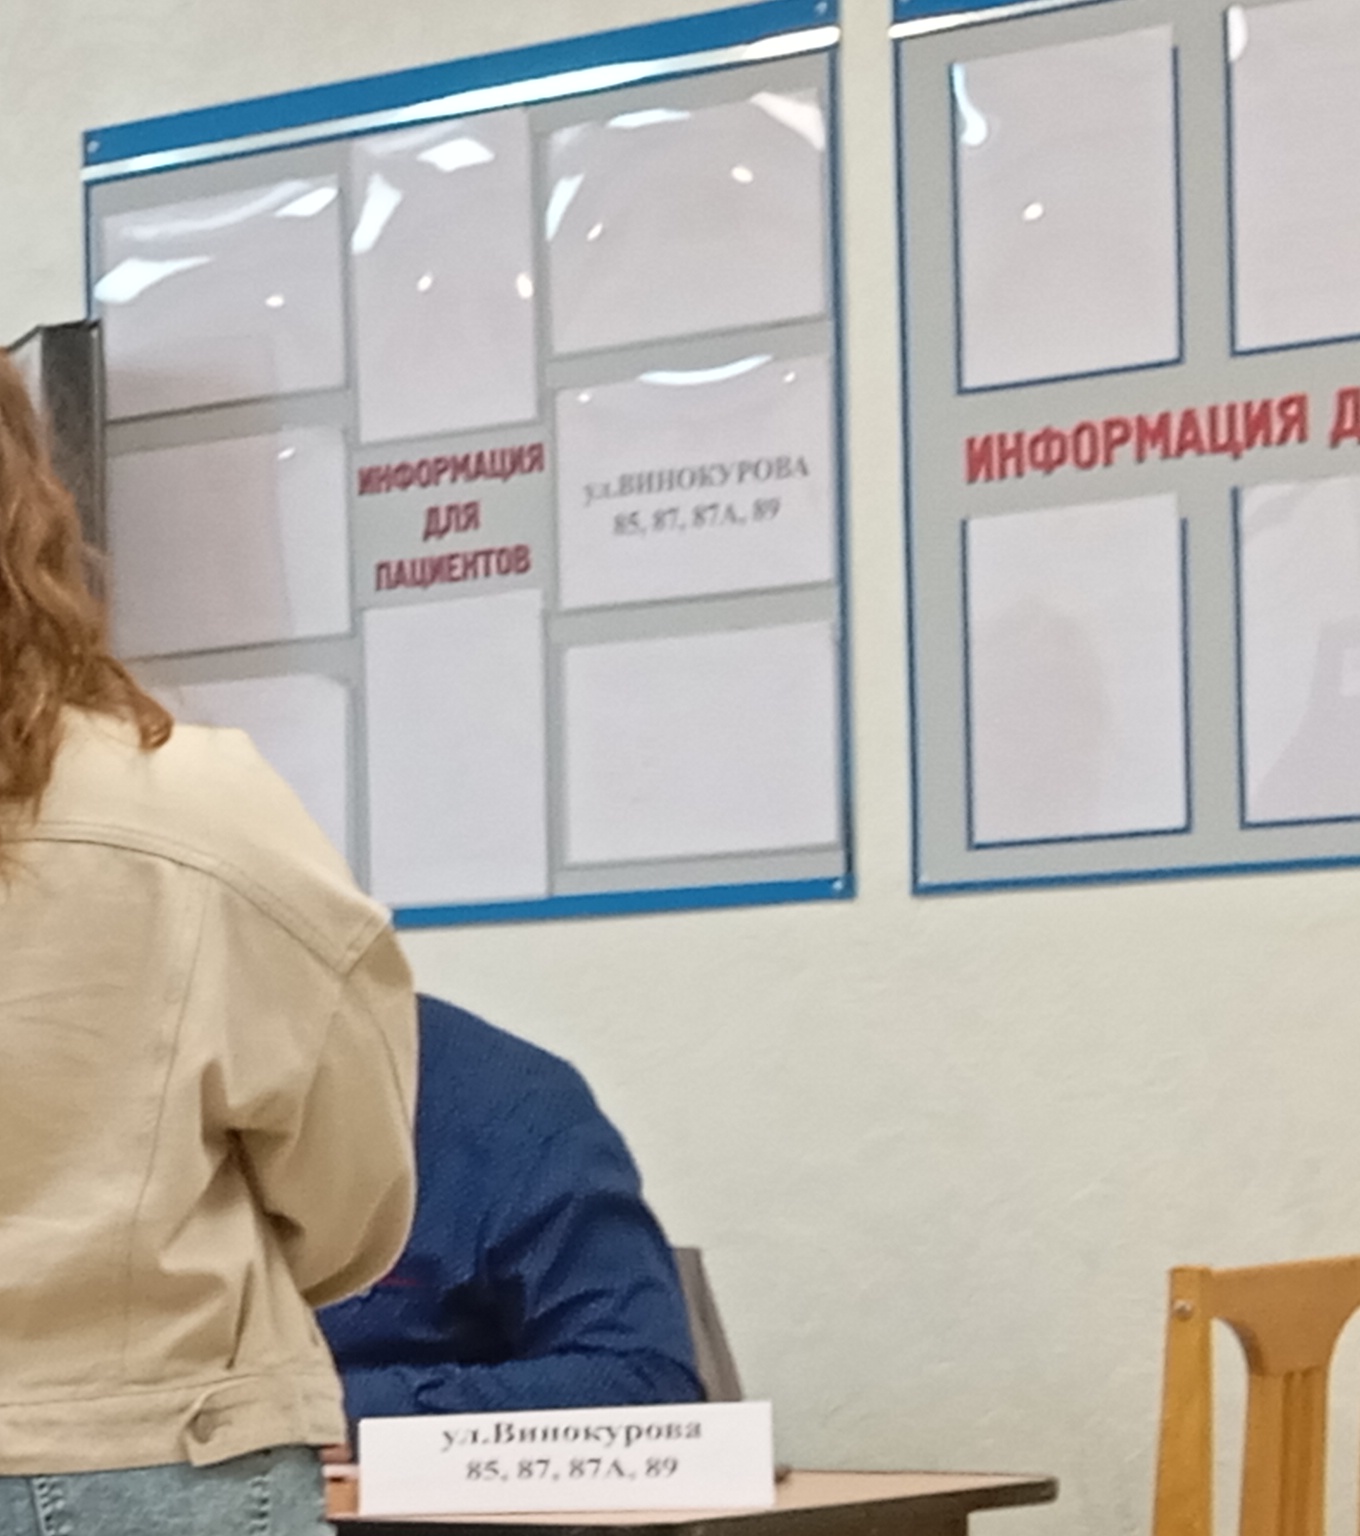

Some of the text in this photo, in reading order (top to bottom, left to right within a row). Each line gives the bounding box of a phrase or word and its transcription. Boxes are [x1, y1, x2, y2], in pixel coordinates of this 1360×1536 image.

[965, 393, 1309, 484] ИНФОРМАЦИЯ
[358, 443, 545, 496] ИНФОРМАЦИЯ
[583, 454, 810, 507] ул.ВИНОКУРОВА
[423, 501, 481, 541] ДЛЯ
[613, 511, 647, 537] 85,
[652, 506, 687, 532] 87,
[752, 497, 782, 521] 89
[376, 545, 531, 592] ПАЦИЕНТОВ
[439, 1420, 703, 1452] ул.Винокурова
[465, 1455, 679, 1483] 85, 87, 87А, 89
